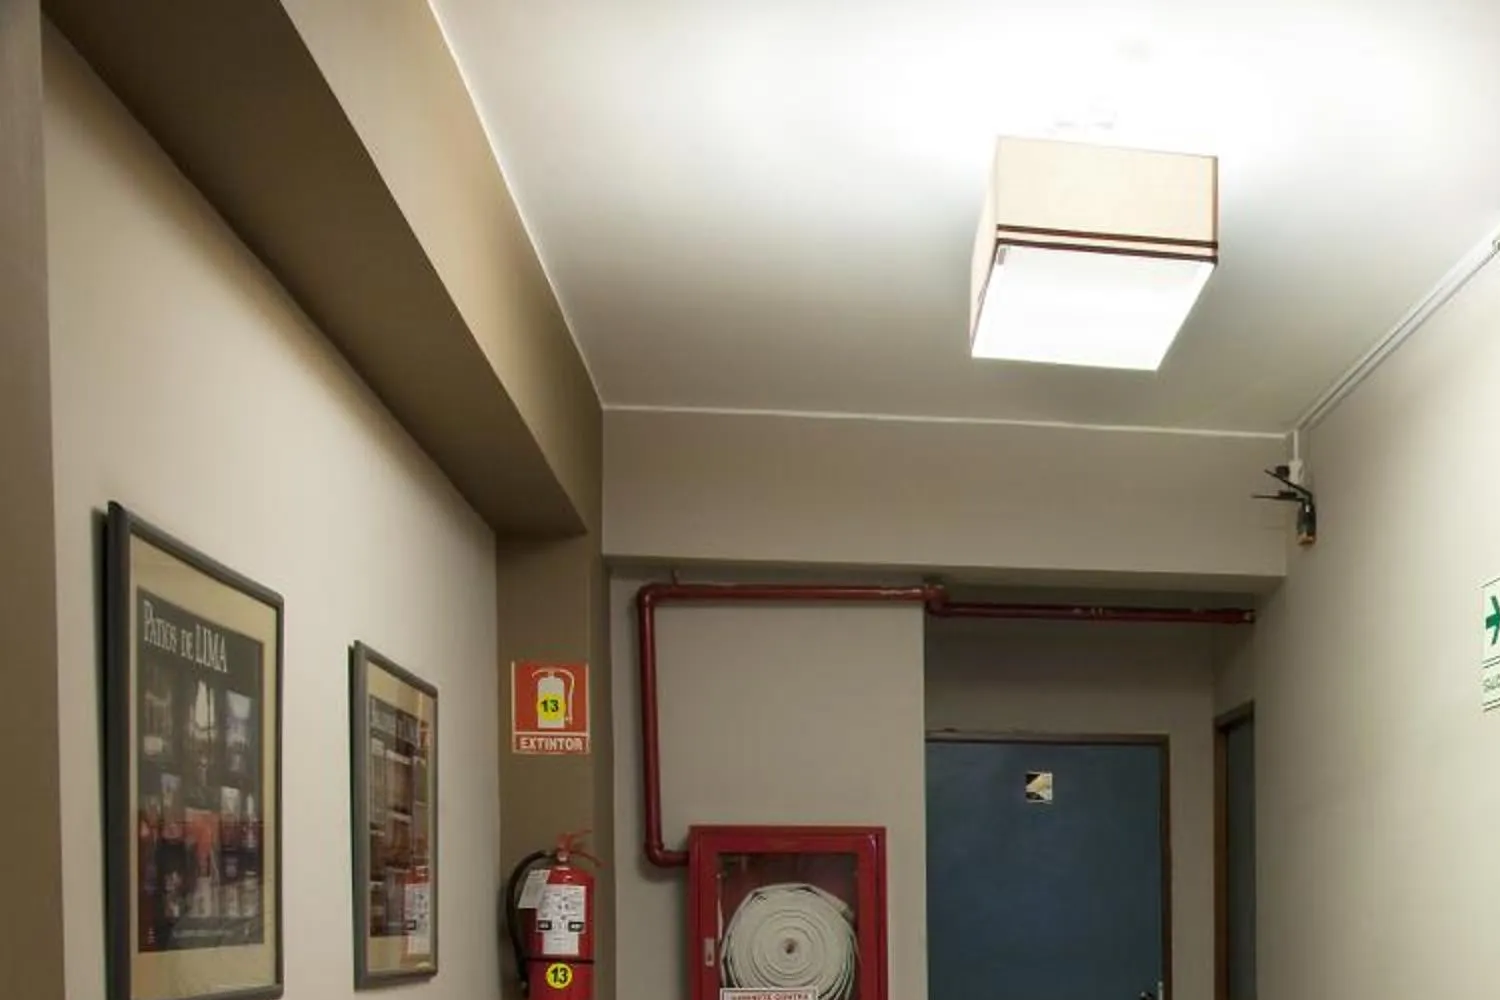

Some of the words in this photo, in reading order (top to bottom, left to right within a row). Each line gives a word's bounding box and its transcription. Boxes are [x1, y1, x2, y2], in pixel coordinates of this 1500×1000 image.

[181, 628, 194, 661] DE
[195, 622, 228, 673] LIMA
[541, 699, 559, 713] 13
[520, 737, 583, 751] EXTINTOR
[551, 967, 569, 984] 13
